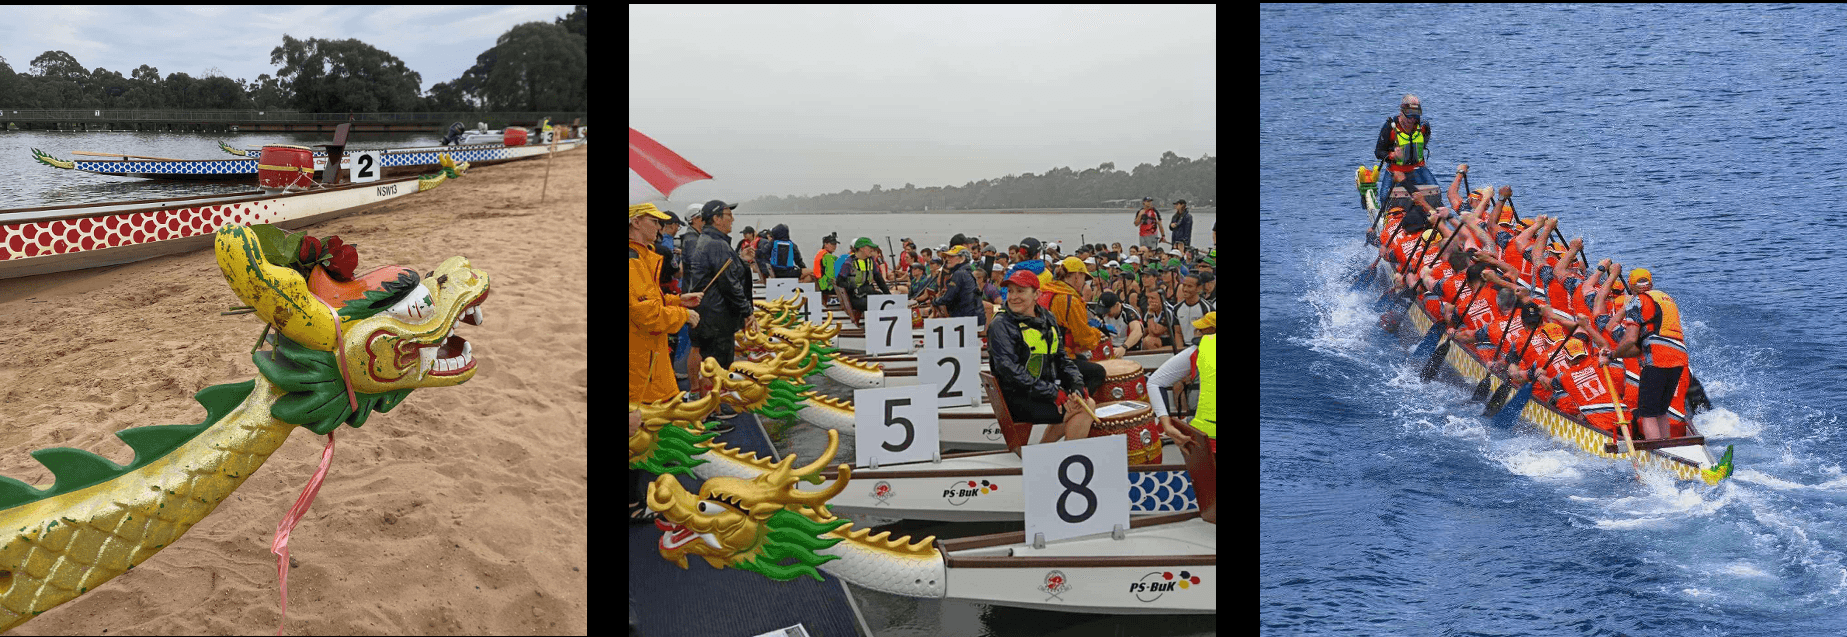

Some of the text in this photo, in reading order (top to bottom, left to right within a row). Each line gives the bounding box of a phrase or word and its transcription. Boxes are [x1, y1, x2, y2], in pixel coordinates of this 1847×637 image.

[547, 132, 554, 142] 3
[358, 154, 373, 178] 2
[376, 184, 398, 197] NSW13
[879, 316, 898, 347] 7
[932, 325, 965, 349] 11
[936, 356, 963, 399] 2
[882, 397, 915, 453] 5
[1056, 454, 1098, 524] 8
[1129, 581, 1177, 593] PS-BuK
